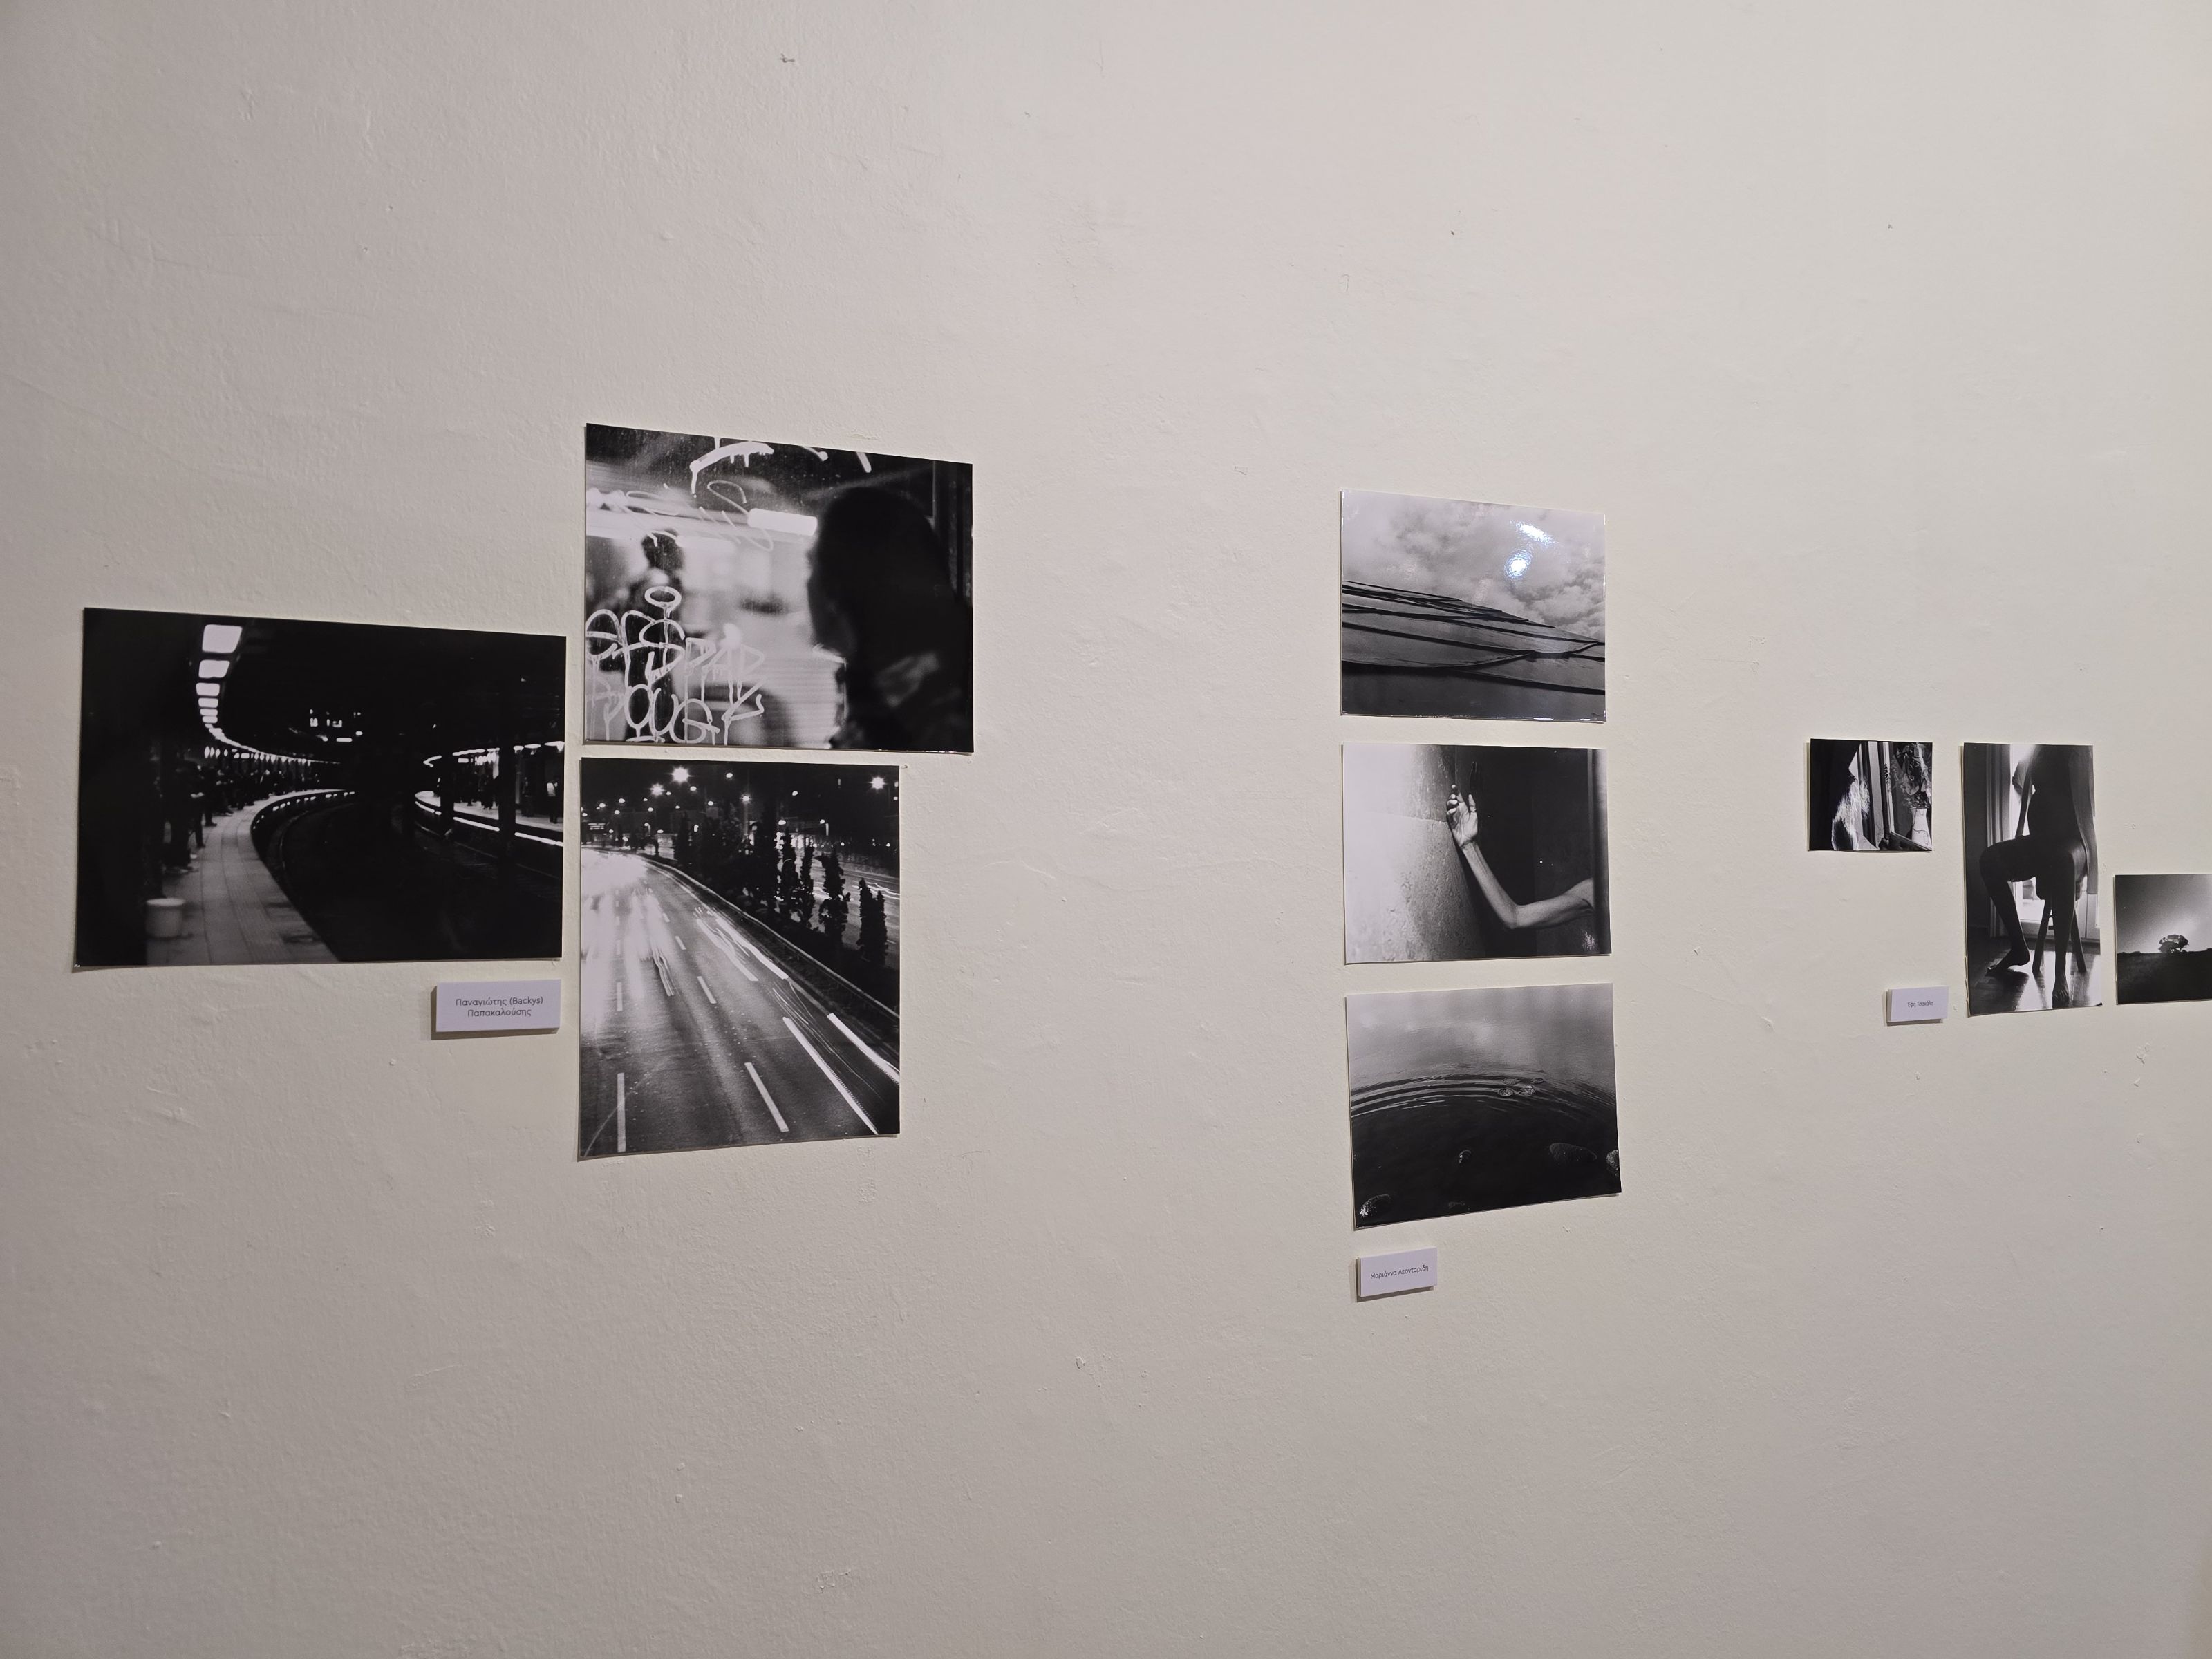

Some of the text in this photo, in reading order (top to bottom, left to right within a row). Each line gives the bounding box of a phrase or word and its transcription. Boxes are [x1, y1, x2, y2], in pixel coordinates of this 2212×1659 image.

[456, 996, 543, 1007] Παναγιώτης (Backys)
[467, 1008, 532, 1018] Παπακαλούσης
[1370, 1264, 1429, 1280] Μαριάννα Λεονταρίδη
